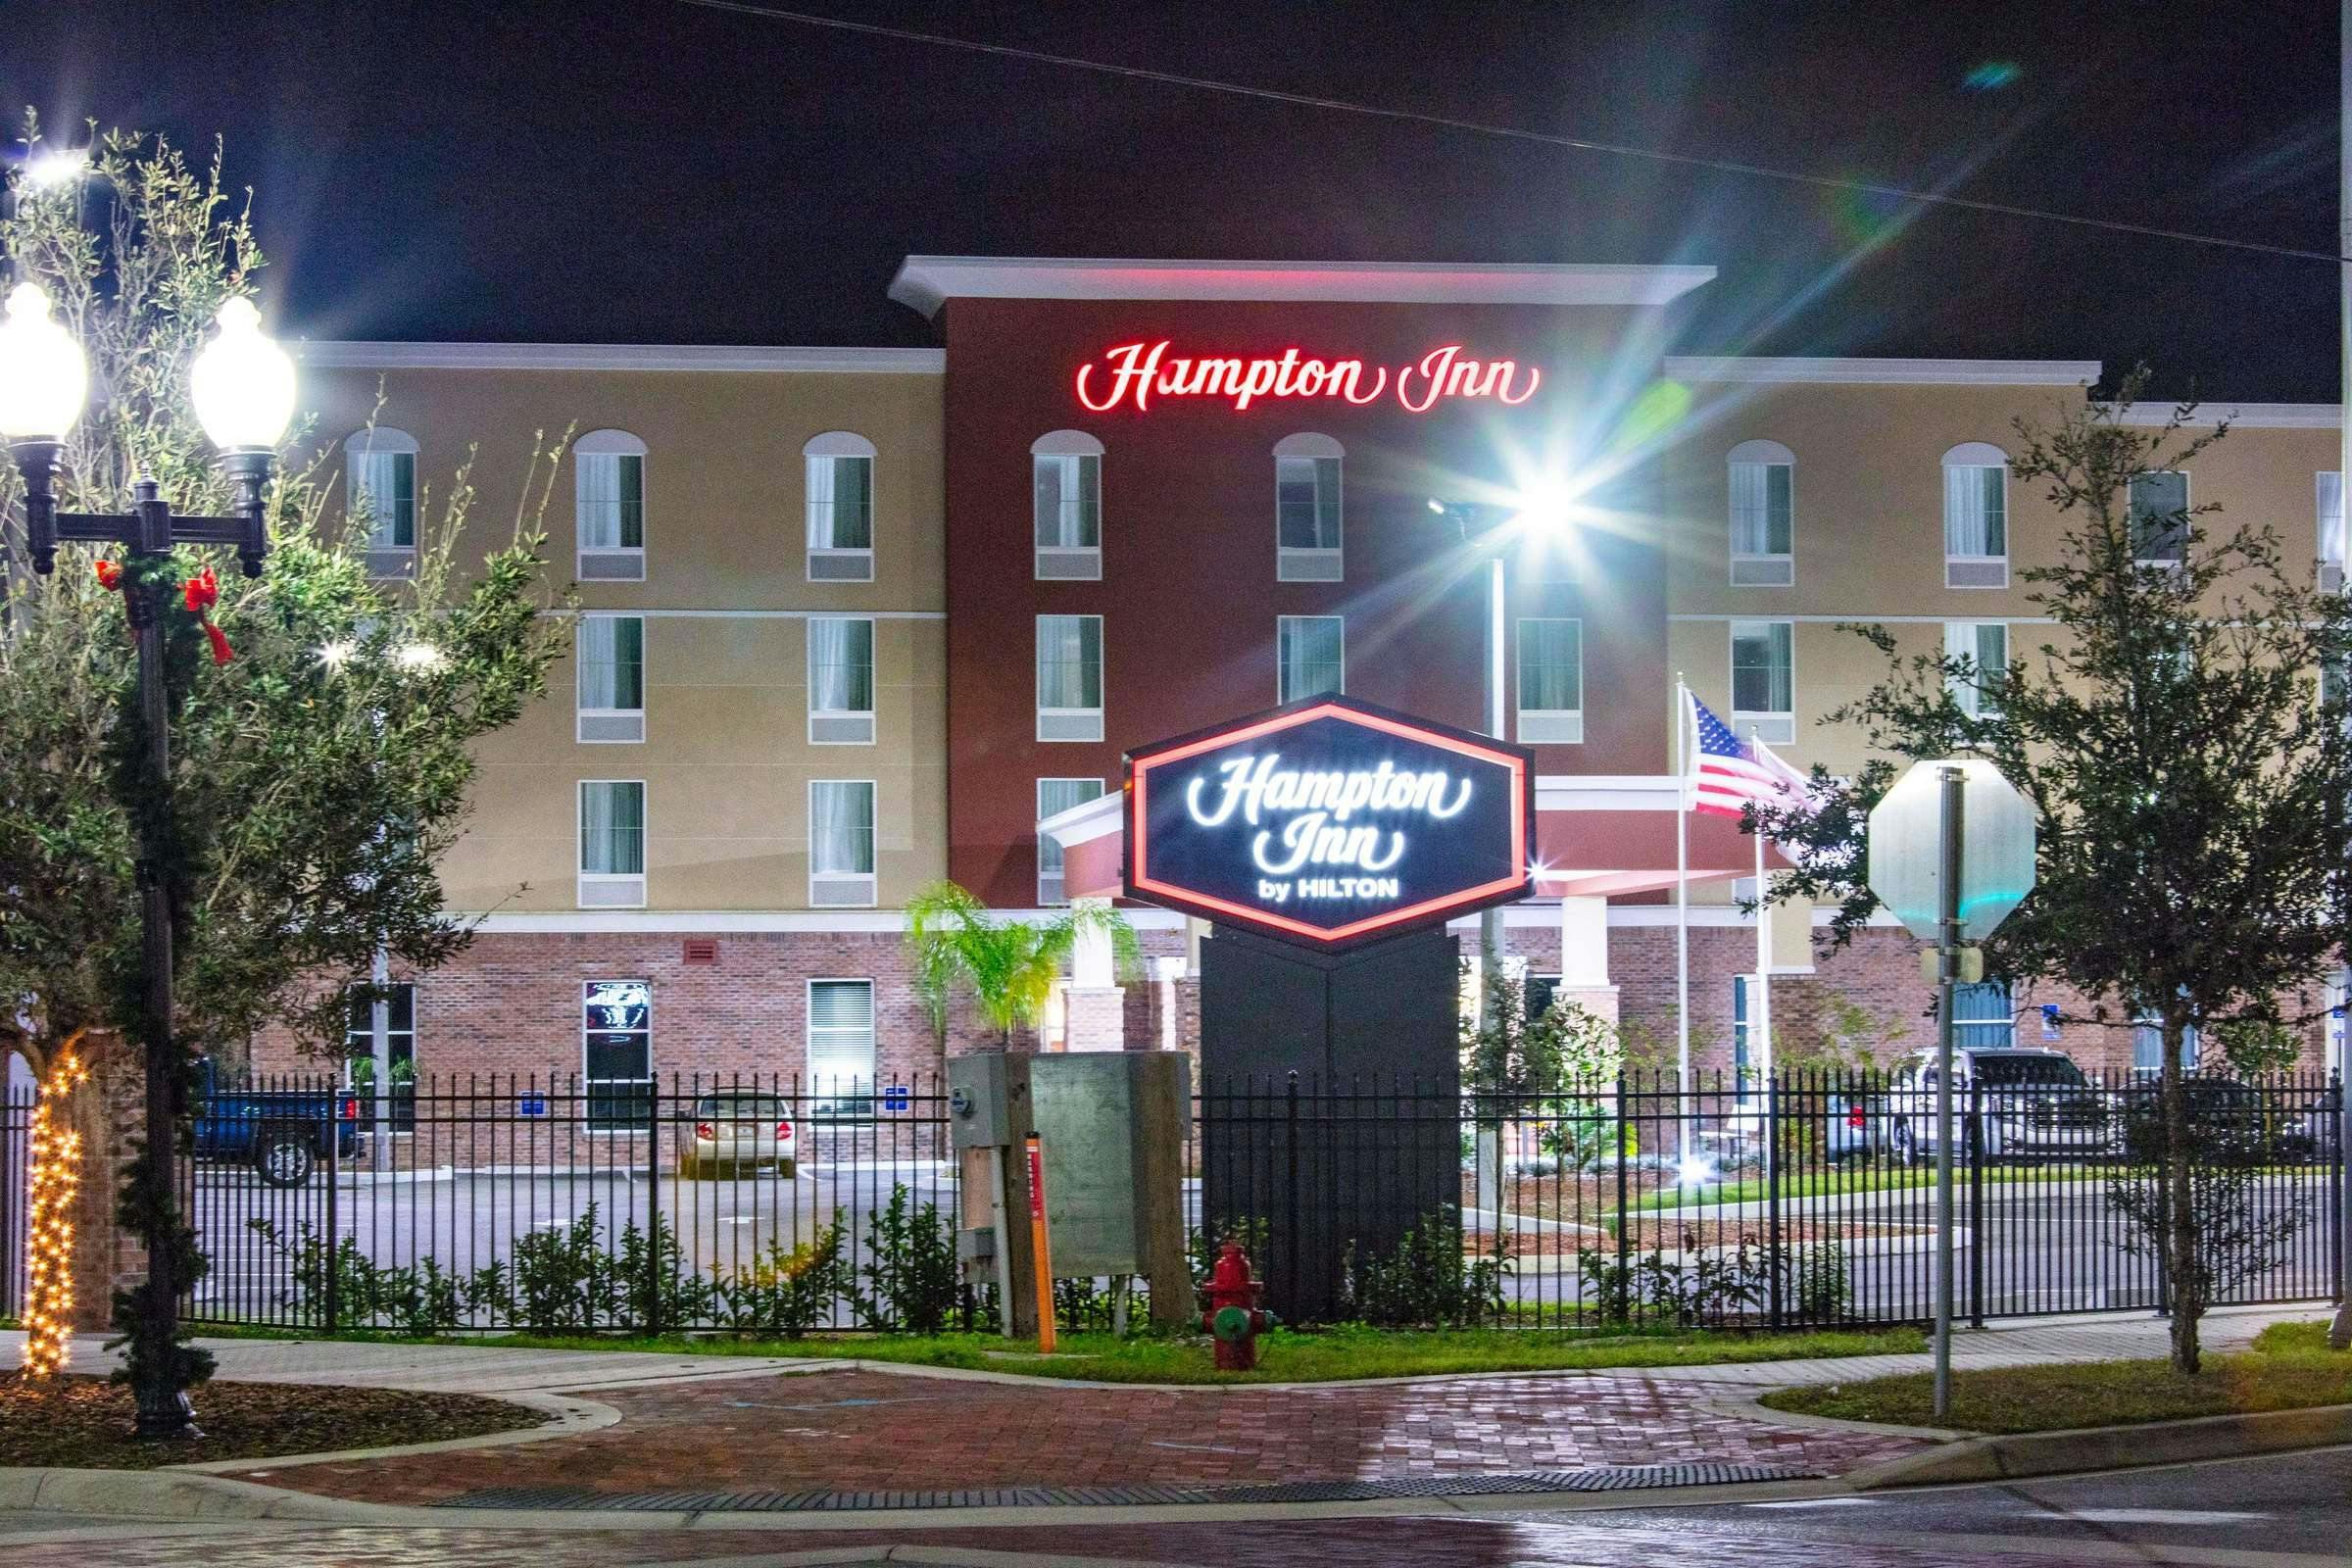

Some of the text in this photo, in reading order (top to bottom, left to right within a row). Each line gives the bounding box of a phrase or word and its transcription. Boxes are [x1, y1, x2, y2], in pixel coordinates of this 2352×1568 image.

[1076, 339, 1542, 414] Hampton Inn
[1186, 753, 1473, 827] Hampton
[1251, 810, 1406, 875] Inn
[1257, 877, 1400, 904] by HILTON
